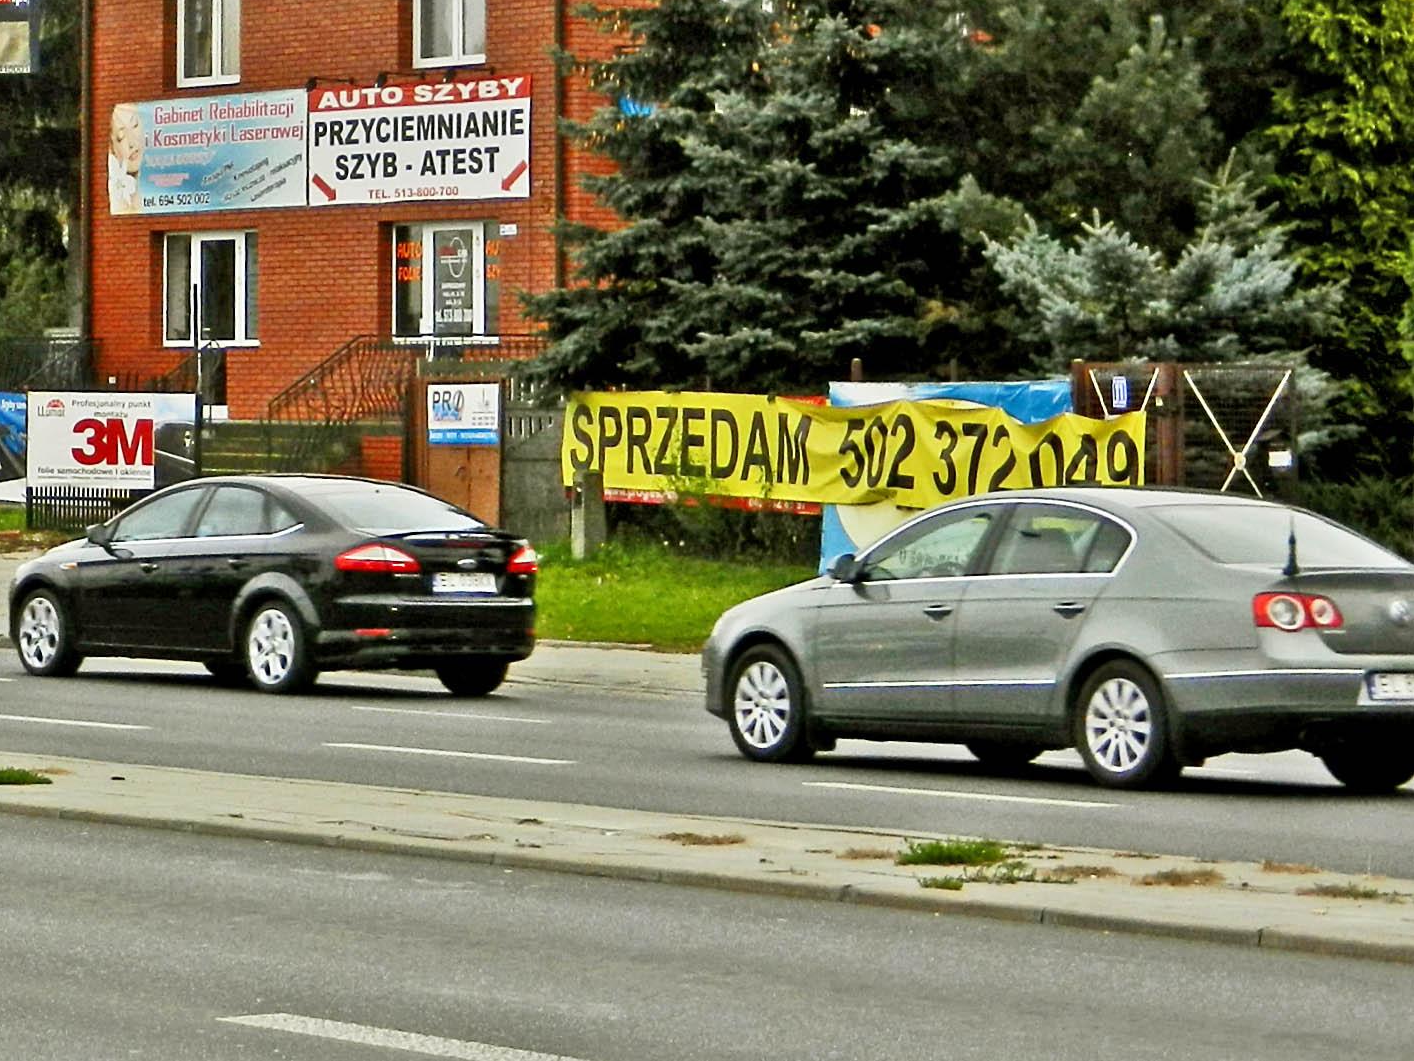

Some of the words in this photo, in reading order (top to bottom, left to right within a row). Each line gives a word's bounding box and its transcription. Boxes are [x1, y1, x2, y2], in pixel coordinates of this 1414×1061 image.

[318, 87, 403, 109] AUTO
[414, 78, 524, 102] SZYBY
[154, 106, 204, 125] Gabinet
[209, 98, 294, 120] Rehabilitacji
[153, 125, 226, 148] Kosmetyki
[231, 120, 304, 141] Laserowej
[314, 109, 524, 147] PRZYCIEMNIANIE
[335, 152, 398, 181] SZYB
[420, 146, 500, 177] ATEST
[143, 197, 157, 207] tel.
[158, 195, 174, 206] 694
[176, 194, 192, 205] 502
[194, 193, 211, 204] 002
[368, 188, 391, 200] TEL.
[394, 186, 459, 198] 513-800-700
[71, 400, 125, 411] Profesjonalny
[128, 400, 151, 410] punkt
[71, 418, 155, 466] 3M
[569, 403, 812, 486] SPRZEDAM
[838, 412, 916, 490] 502
[932, 419, 1016, 495] 372
[57, 466, 114, 476] samochodowe
